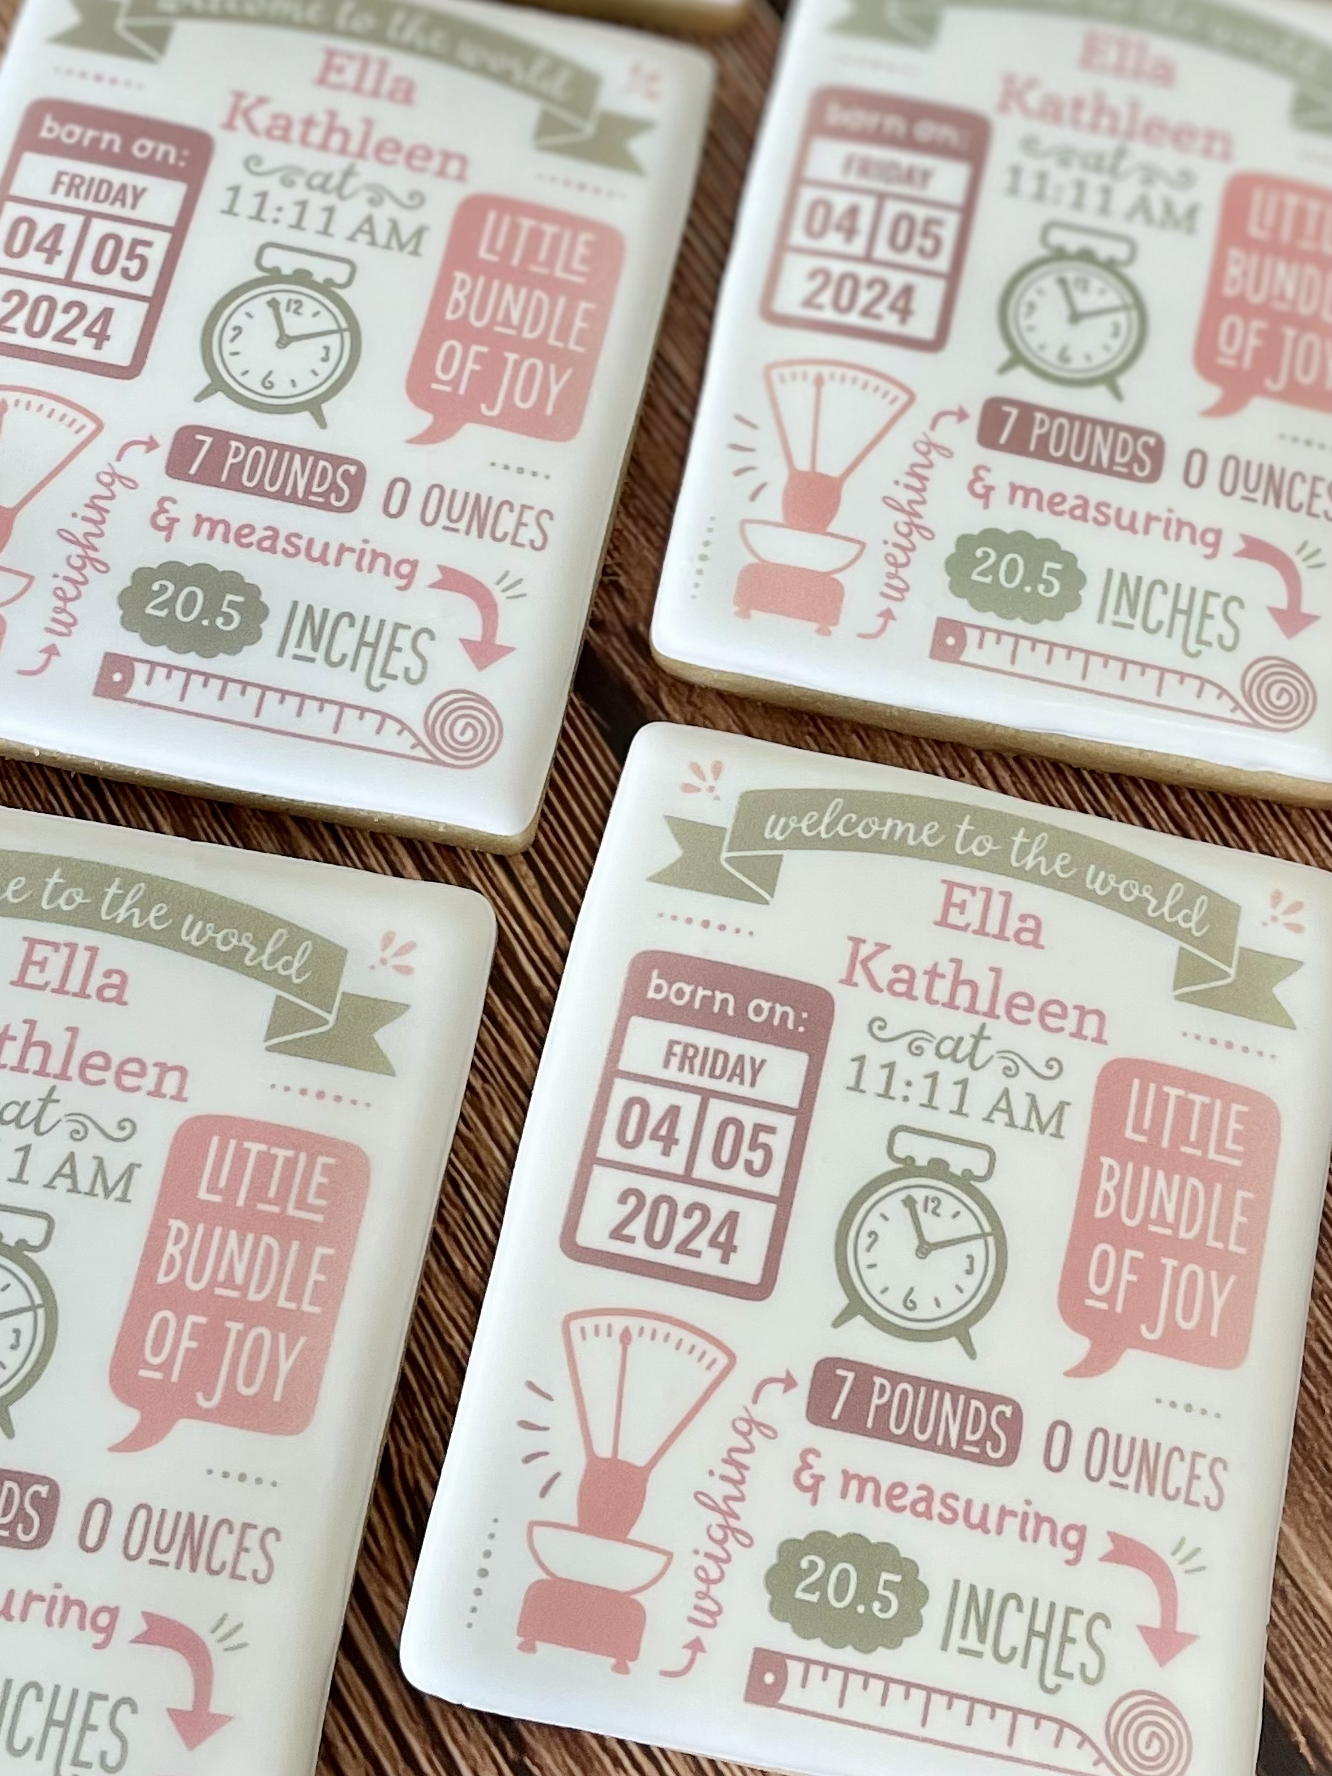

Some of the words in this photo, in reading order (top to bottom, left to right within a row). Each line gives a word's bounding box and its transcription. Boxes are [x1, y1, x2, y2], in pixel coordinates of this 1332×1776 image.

[314, 44, 417, 106] Ella
[1078, 28, 1177, 90] Ella
[38, 113, 122, 154] born
[131, 135, 190, 168] on:
[219, 90, 470, 183] Kathleen
[825, 104, 907, 139] born
[995, 72, 1235, 163] Kathleen
[50, 170, 149, 211] FRIDAY
[305, 160, 361, 202] at
[841, 153, 935, 191] FRIDAY
[1003, 164, 1115, 221] 11:11
[1123, 189, 1201, 236] AM
[4, 215, 66, 266] 04
[90, 232, 155, 282] 05
[220, 185, 337, 238] 11:11
[342, 217, 430, 258] AM
[478, 209, 597, 283] LITTLE
[804, 198, 860, 244] 04
[887, 211, 945, 260] 05
[0, 288, 115, 351] 2024
[285, 298, 303, 316] 12
[444, 272, 597, 355] BUNDLE
[801, 266, 915, 327] 2024
[261, 370, 274, 390] 6
[430, 338, 483, 396] OF
[480, 350, 574, 418] JOY
[1216, 313, 1267, 371] OF
[186, 434, 212, 476] 7
[220, 440, 358, 508] POUNDS
[420, 482, 553, 552] OUNCES
[998, 407, 1018, 445] 7
[1029, 412, 1157, 478] POUNDS
[1219, 454, 1332, 522] OUNCE
[45, 457, 139, 638] weighing
[149, 496, 180, 542] &
[192, 510, 419, 590] measuring
[880, 429, 953, 603] weighing
[967, 465, 996, 509] &
[1008, 478, 1223, 560] measuring
[144, 579, 245, 632] 20.5
[276, 599, 436, 692] INCHES
[970, 545, 1064, 599] 20.5
[1096, 567, 1246, 659] INCHES
[761, 798, 946, 850] welcome
[953, 814, 1001, 858] to
[1009, 833, 1076, 881] the
[1084, 864, 1210, 938] world
[40, 868, 91, 911] to
[100, 877, 173, 930] the
[180, 913, 314, 985] world
[933, 878, 1045, 951] Ella
[9, 936, 129, 1006] Ella
[646, 969, 735, 1017] born
[745, 998, 810, 1034] on:
[838, 936, 1108, 1046] Kathleen
[0, 1018, 188, 1102] thleen
[662, 1038, 767, 1089] FRIDAY
[935, 1024, 997, 1073] at
[614, 1095, 680, 1159] 04
[710, 1116, 777, 1180] 05
[846, 1055, 970, 1119] 11:11
[980, 1088, 1071, 1141] AM
[1125, 1077, 1250, 1167] LITTLE
[43, 1151, 142, 1203] AM
[197, 1135, 337, 1223] LITTLE
[923, 1195, 941, 1217] 12
[1093, 1156, 1254, 1255] BUNDLE
[155, 1217, 336, 1315] BUNDLE
[608, 1187, 742, 1266] 2024
[902, 1286, 917, 1311] 6
[1084, 1243, 1140, 1314] OF
[1140, 1258, 1238, 1342] JOY
[137, 1309, 207, 1383] OF
[195, 1320, 308, 1410] JOY
[830, 1368, 857, 1422] 7
[865, 1375, 1014, 1461] POUNDS
[1085, 1425, 1228, 1513] OUNCES
[122, 1502, 282, 1585] OUNCES
[686, 1409, 779, 1632] weighing
[792, 1448, 825, 1505] &
[840, 1468, 1089, 1568] measuring
[794, 1553, 905, 1620] 20.5
[941, 1578, 1113, 1695] INCHES
[0, 1678, 138, 1776] CHES
